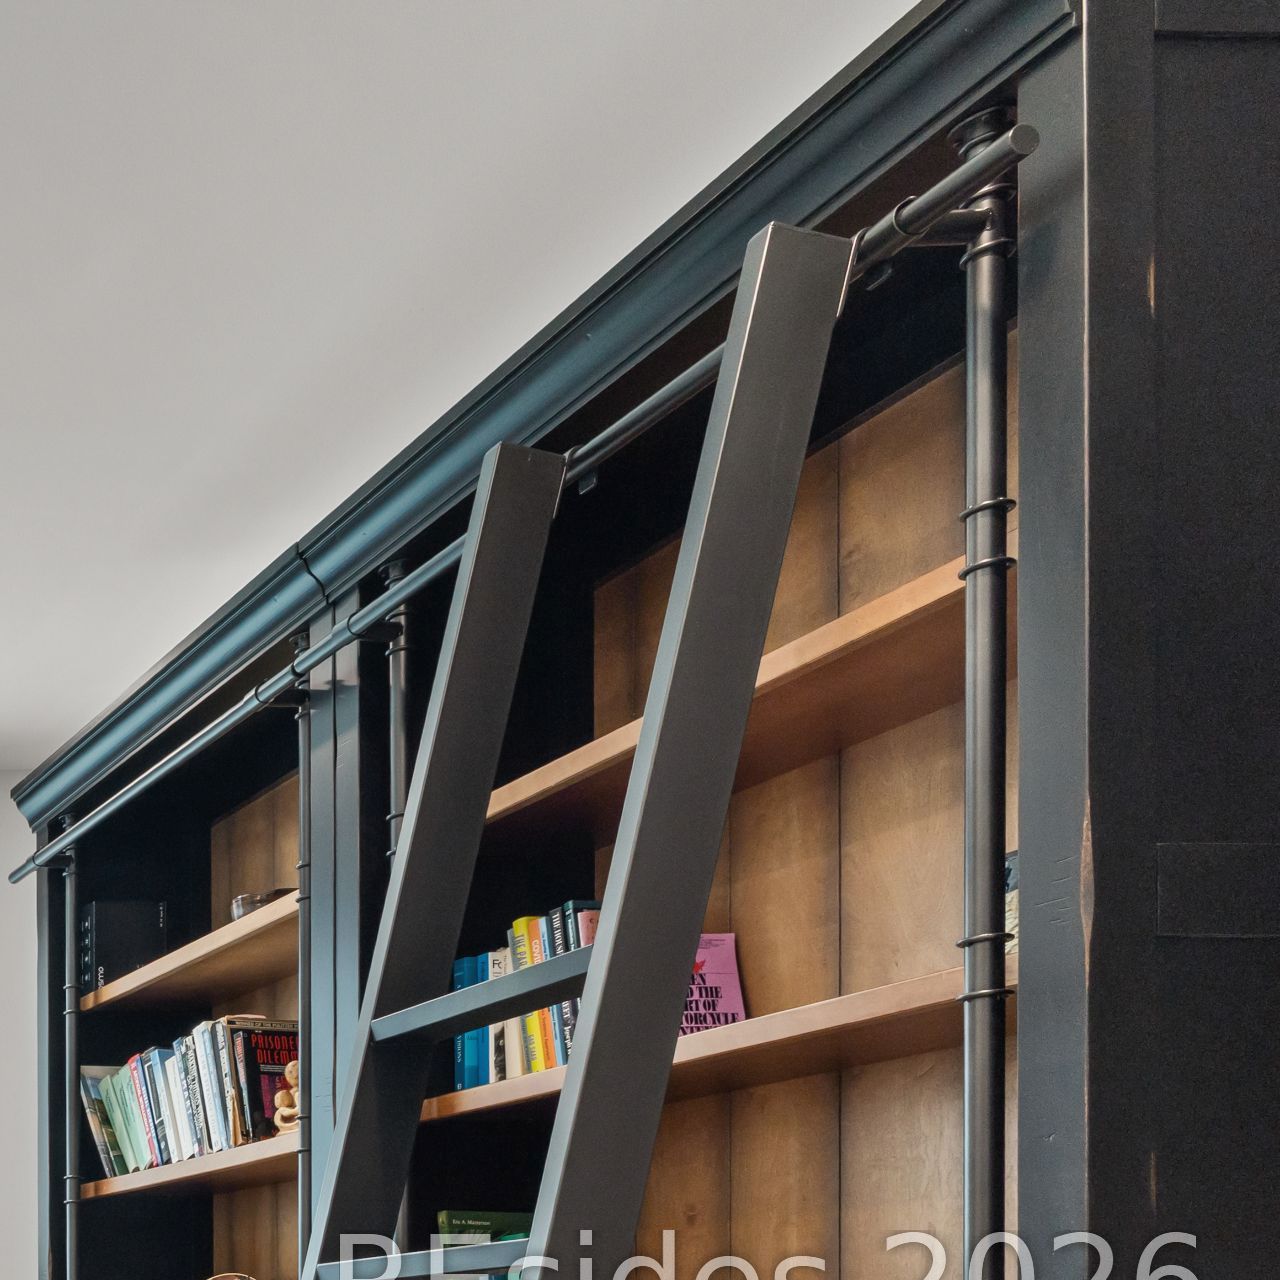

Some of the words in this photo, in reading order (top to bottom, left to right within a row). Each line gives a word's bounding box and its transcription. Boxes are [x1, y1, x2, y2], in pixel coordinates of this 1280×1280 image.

[690, 973, 706, 985] EN
[696, 986, 722, 998] THE
[702, 999, 718, 1011] OF
[683, 1012, 738, 1024] ORCYCLE
[256, 1049, 298, 1064] DILEMM
